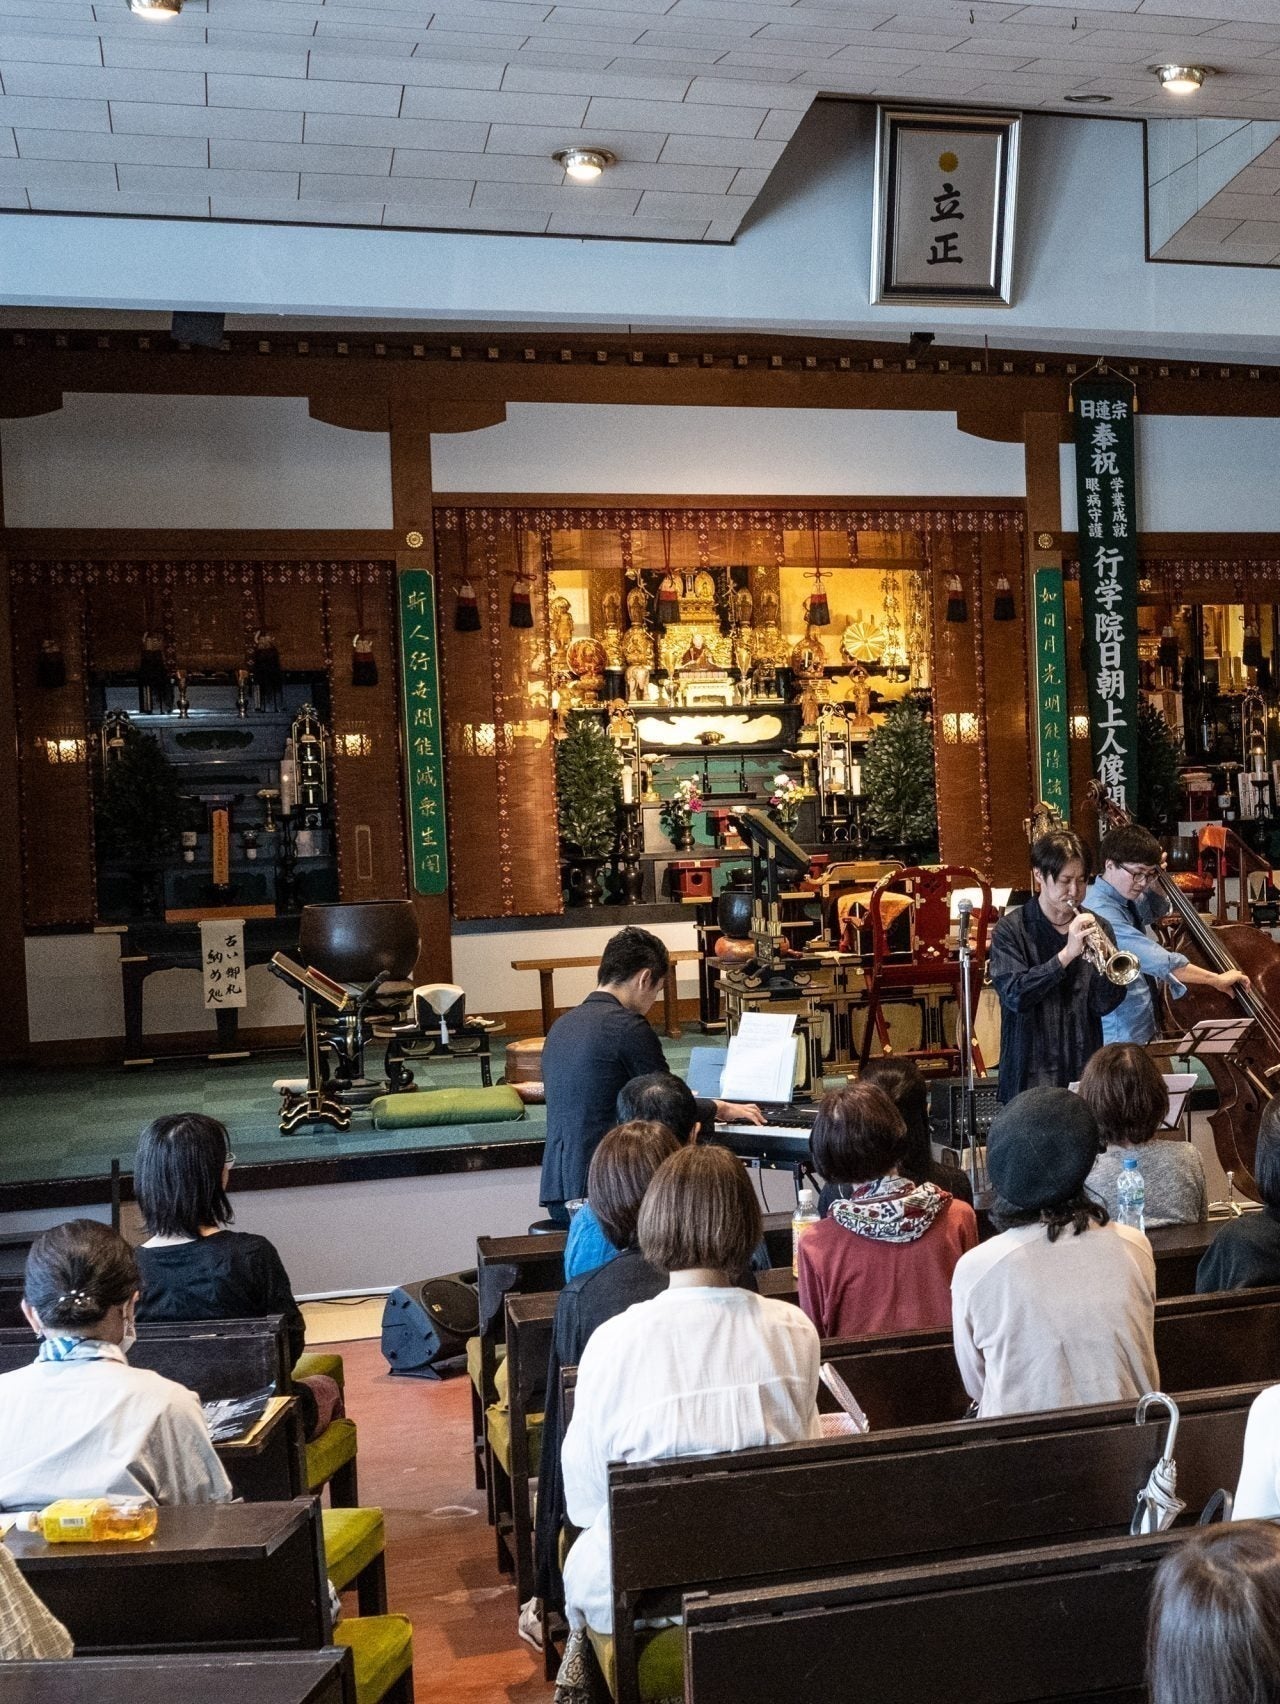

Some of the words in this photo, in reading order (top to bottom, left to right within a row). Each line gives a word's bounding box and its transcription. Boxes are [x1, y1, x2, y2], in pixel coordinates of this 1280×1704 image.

[926, 183, 965, 265] 立正
[1080, 399, 1128, 420] 日蓮宗
[1090, 422, 1119, 475] 奉祝
[1085, 478, 1104, 539] 眼病守護
[1110, 477, 1128, 538] 学業成就
[224, 934, 242, 995] 古い御札
